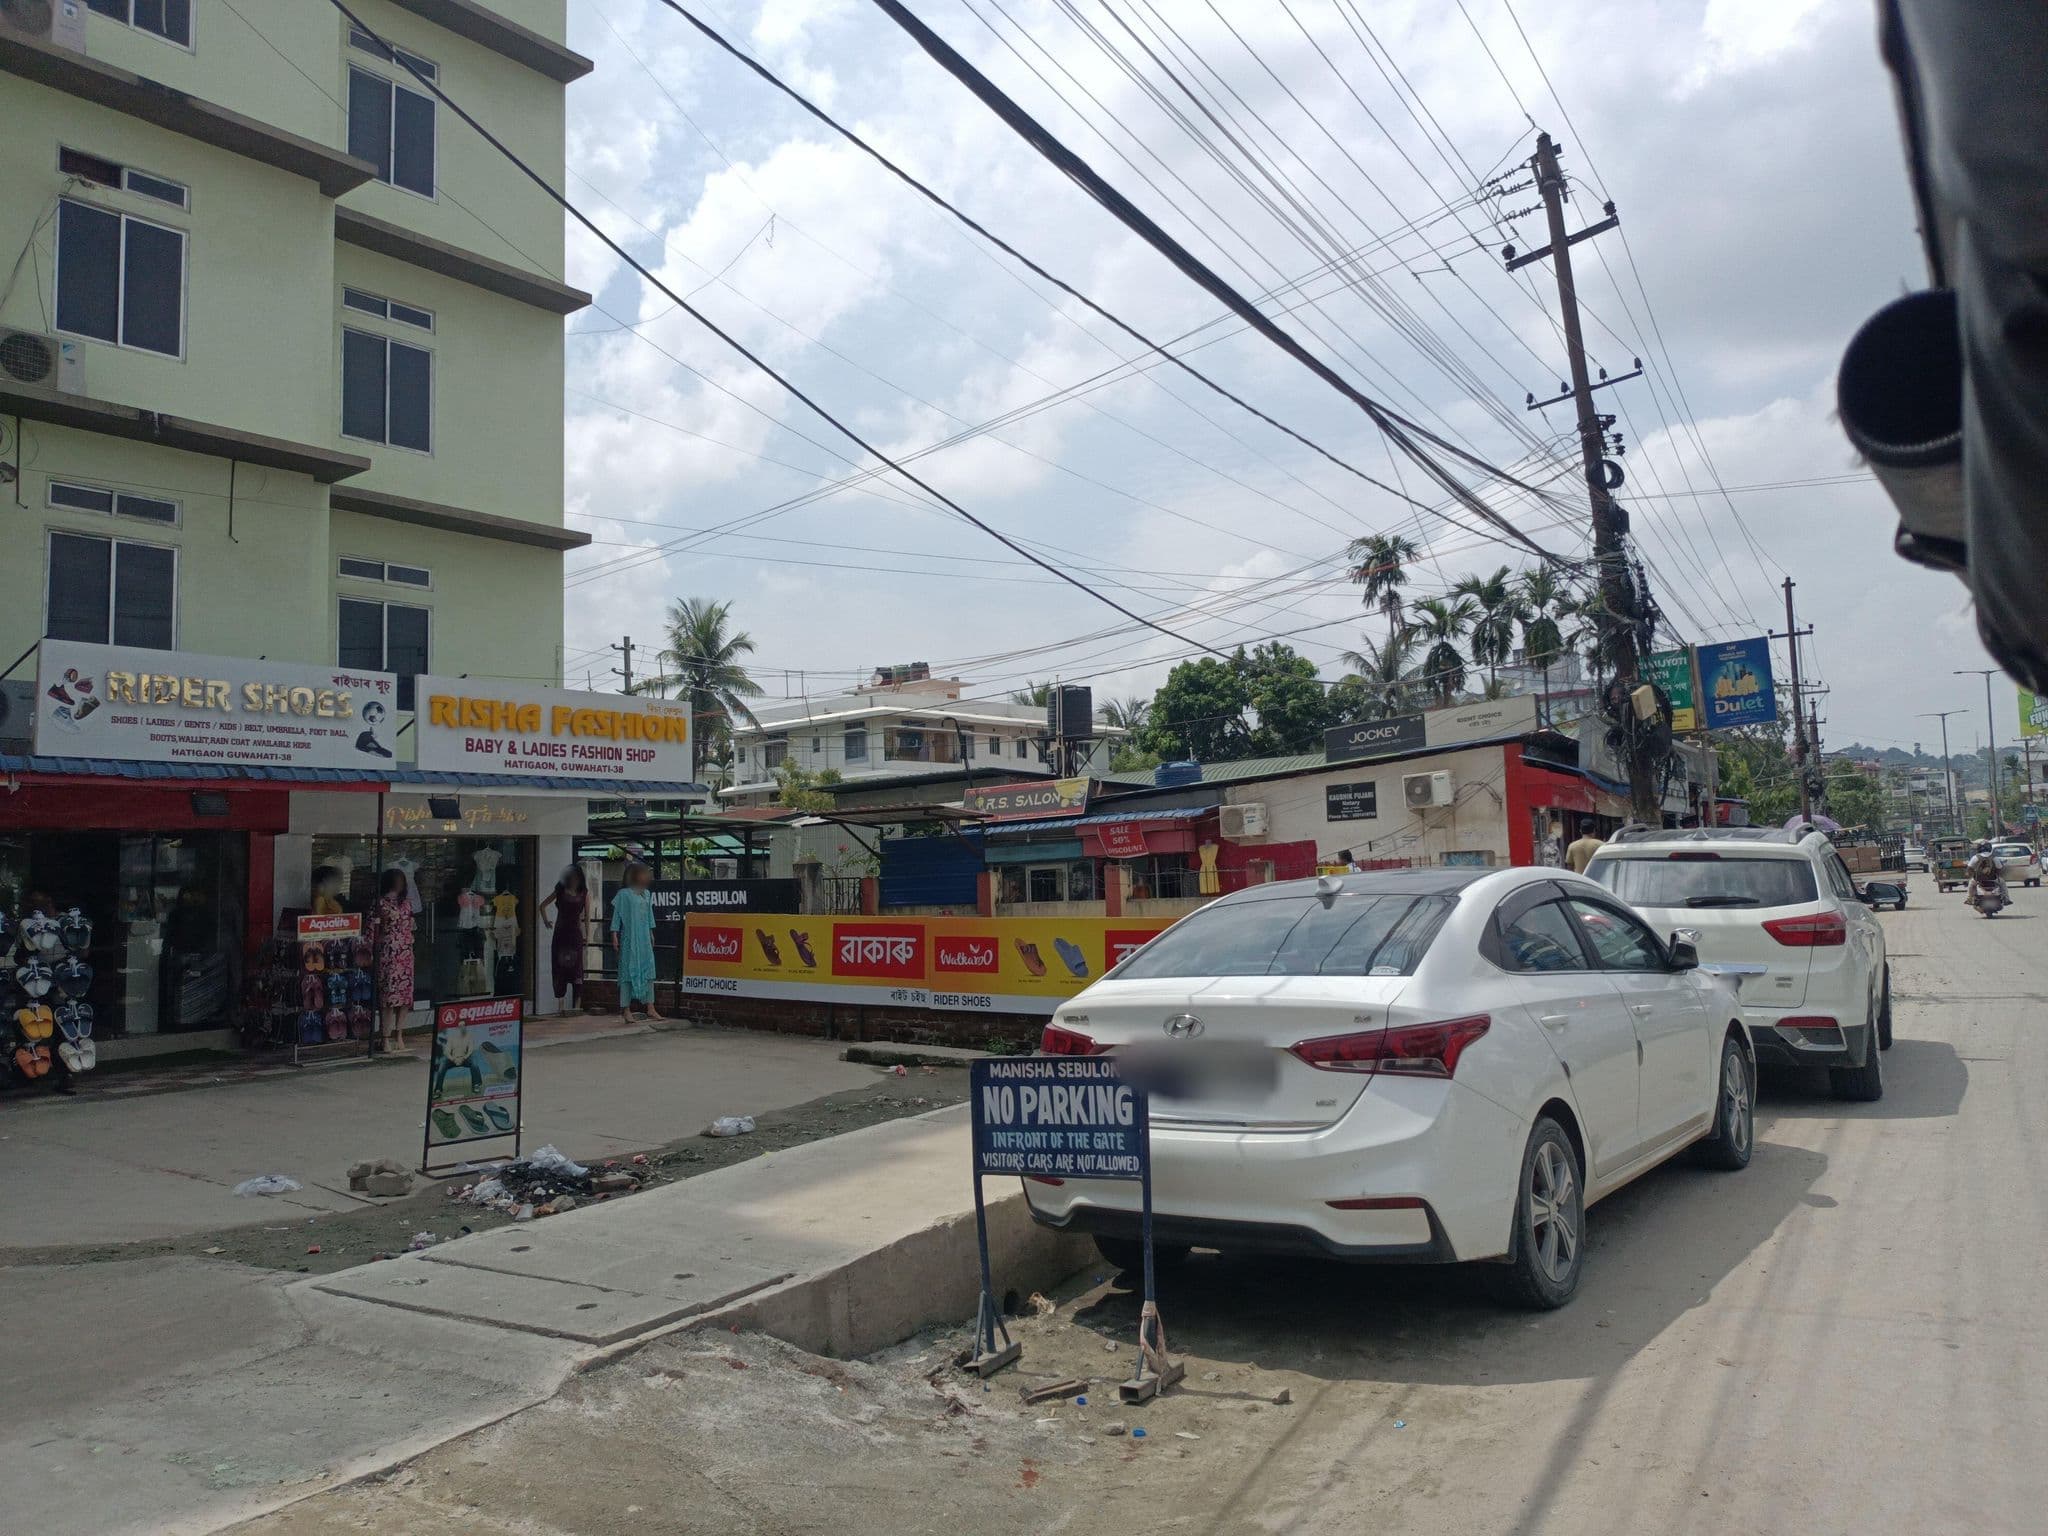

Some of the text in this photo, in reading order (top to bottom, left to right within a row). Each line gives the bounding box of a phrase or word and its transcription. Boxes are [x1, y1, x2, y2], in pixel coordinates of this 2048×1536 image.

[105, 671, 354, 718] RIDER SHOES
[1714, 696, 1765, 714] Dulet
[429, 694, 688, 744] RISHA FASHION
[1477, 711, 1503, 720] CHOICE
[111, 716, 138, 725] SHOES
[146, 717, 175, 727] LADIES
[184, 720, 211, 730] GENTS
[218, 722, 237, 731] KIDS
[309, 727, 328, 737] FOOT
[1348, 725, 1401, 744] JOCKEY
[230, 737, 250, 746] COAT
[252, 739, 291, 749] AVAILABLE
[293, 741, 312, 750] HERE
[465, 737, 656, 762] BABY & LADIES FASHION SHOP
[171, 748, 292, 761] HATIGAON GUWAHATI-38
[504, 760, 624, 774] HATIGAON, GUWAHATI-38
[985, 791, 1061, 810] R.S. SALON
[1109, 825, 1129, 834] SALE
[1107, 844, 1143, 854] DISCOUNT
[696, 890, 747, 906] SEBULON
[309, 917, 350, 931] Aqualite
[685, 977, 738, 991] RIGHT CHOICE
[934, 994, 991, 1007] RIDER SHOES
[459, 1001, 514, 1021] aqualite
[989, 1062, 1120, 1078] MANISHA SEBULON
[983, 1085, 1133, 1126] NO PARKING
[992, 1132, 1126, 1150] INFRONT OF THE GATE
[1027, 1153, 1053, 1173] CARS
[1055, 1154, 1074, 1173] ARE
[1077, 1155, 1095, 1173] NOT
[1096, 1154, 1140, 1172] ALLOWED
